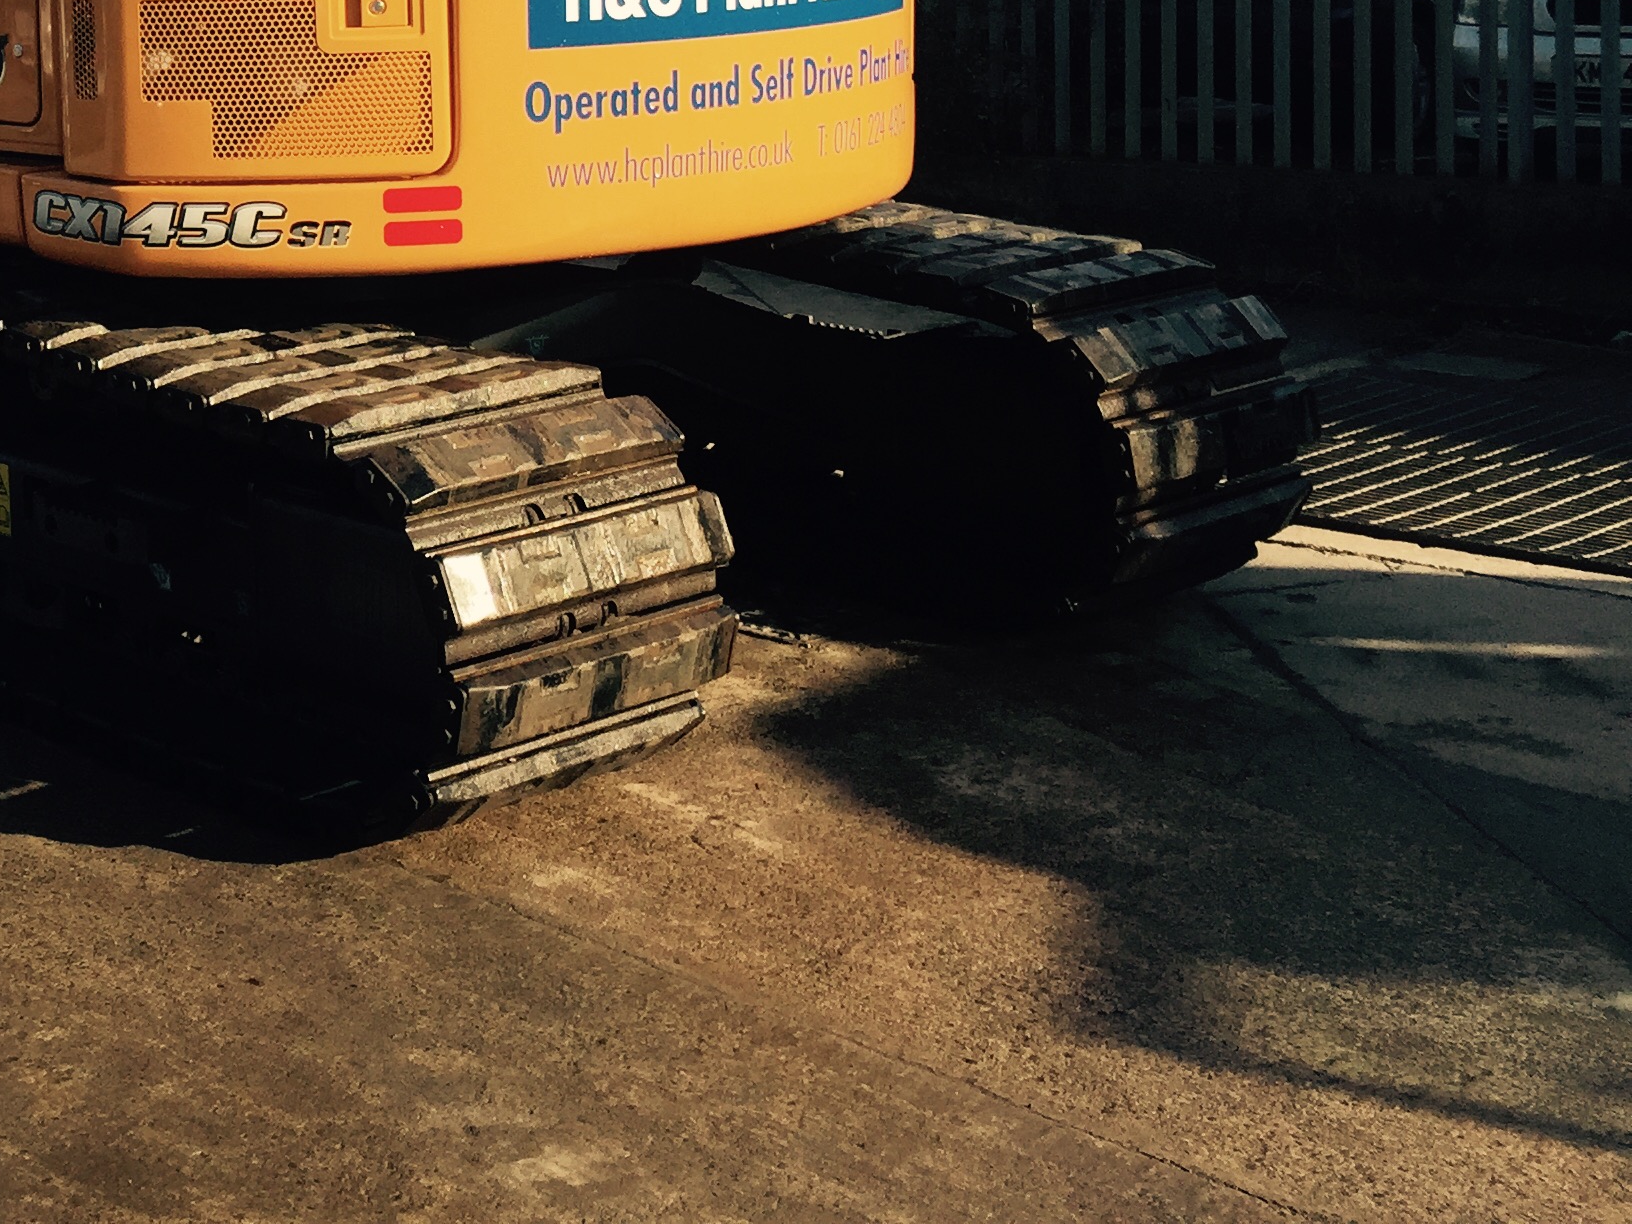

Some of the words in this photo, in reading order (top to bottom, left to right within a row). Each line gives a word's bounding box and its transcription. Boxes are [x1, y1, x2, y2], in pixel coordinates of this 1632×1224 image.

[524, 69, 678, 134] Operated
[691, 63, 740, 110] and
[751, 57, 794, 104] Self
[803, 56, 854, 96] Drive
[860, 44, 891, 86] Plant
[547, 130, 794, 188] www.hcplanthire.co.uk
[818, 124, 828, 158] T:
[834, 117, 861, 154] 0161
[868, 111, 885, 146] 224
[34, 189, 287, 251] CX145C
[287, 220, 353, 249] SR
